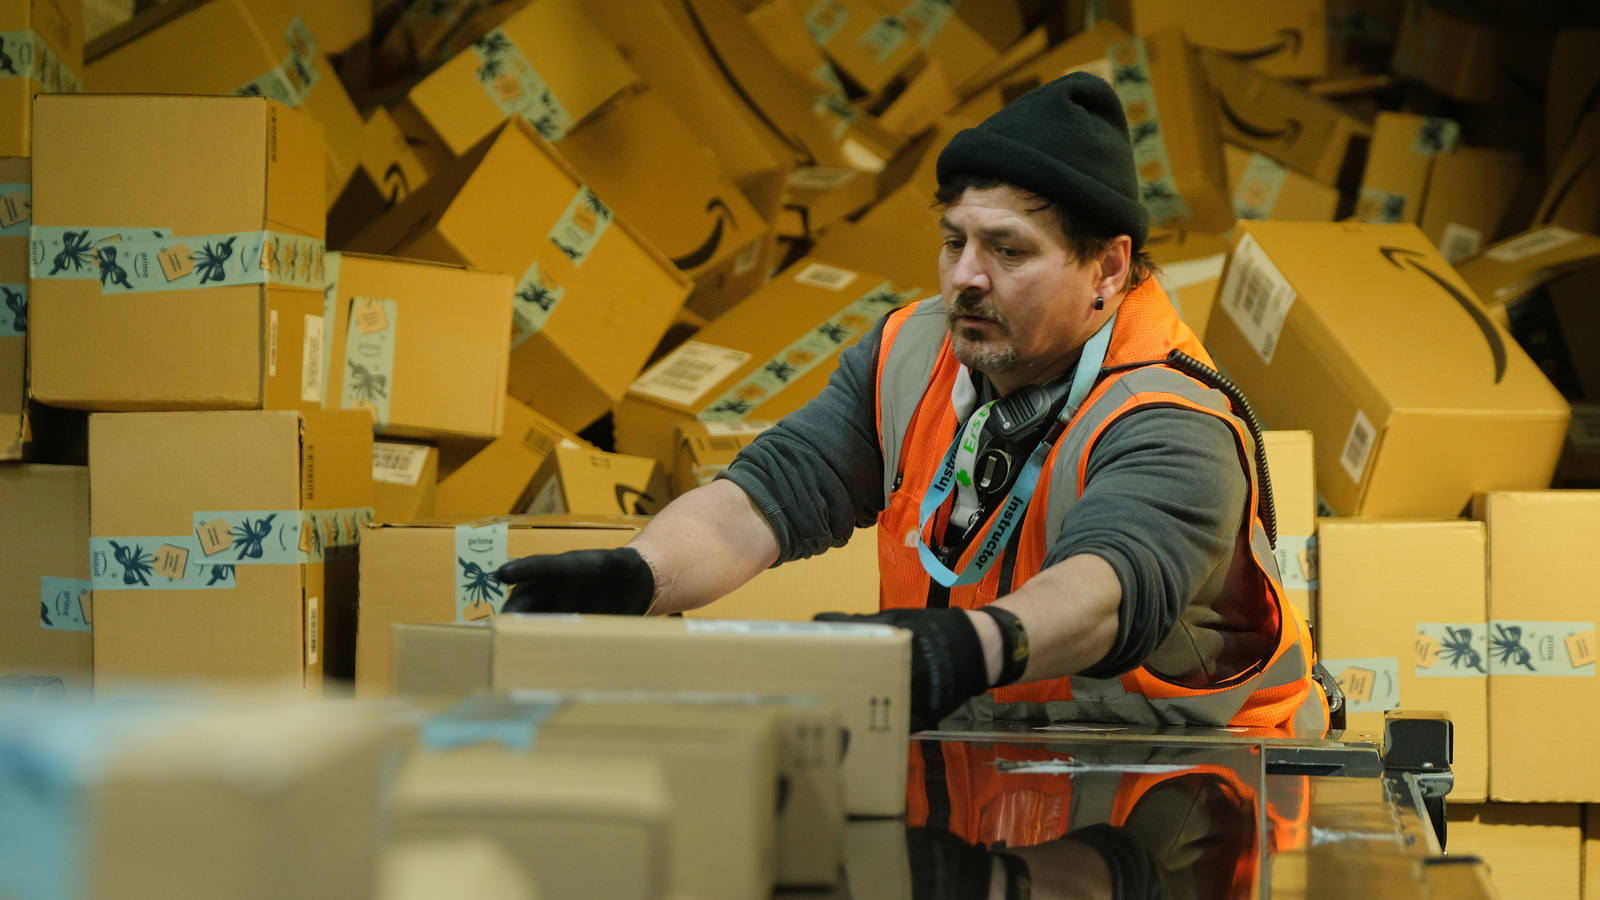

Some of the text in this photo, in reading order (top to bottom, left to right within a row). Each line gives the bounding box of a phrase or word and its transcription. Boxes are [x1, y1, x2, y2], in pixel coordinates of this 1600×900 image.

[140, 252, 149, 277] prime
[468, 536, 494, 546] prime
[977, 495, 1024, 571] Instructor
[91, 550, 100, 576] prime
[63, 590, 73, 616] prime
[1547, 634, 1557, 661] prime
